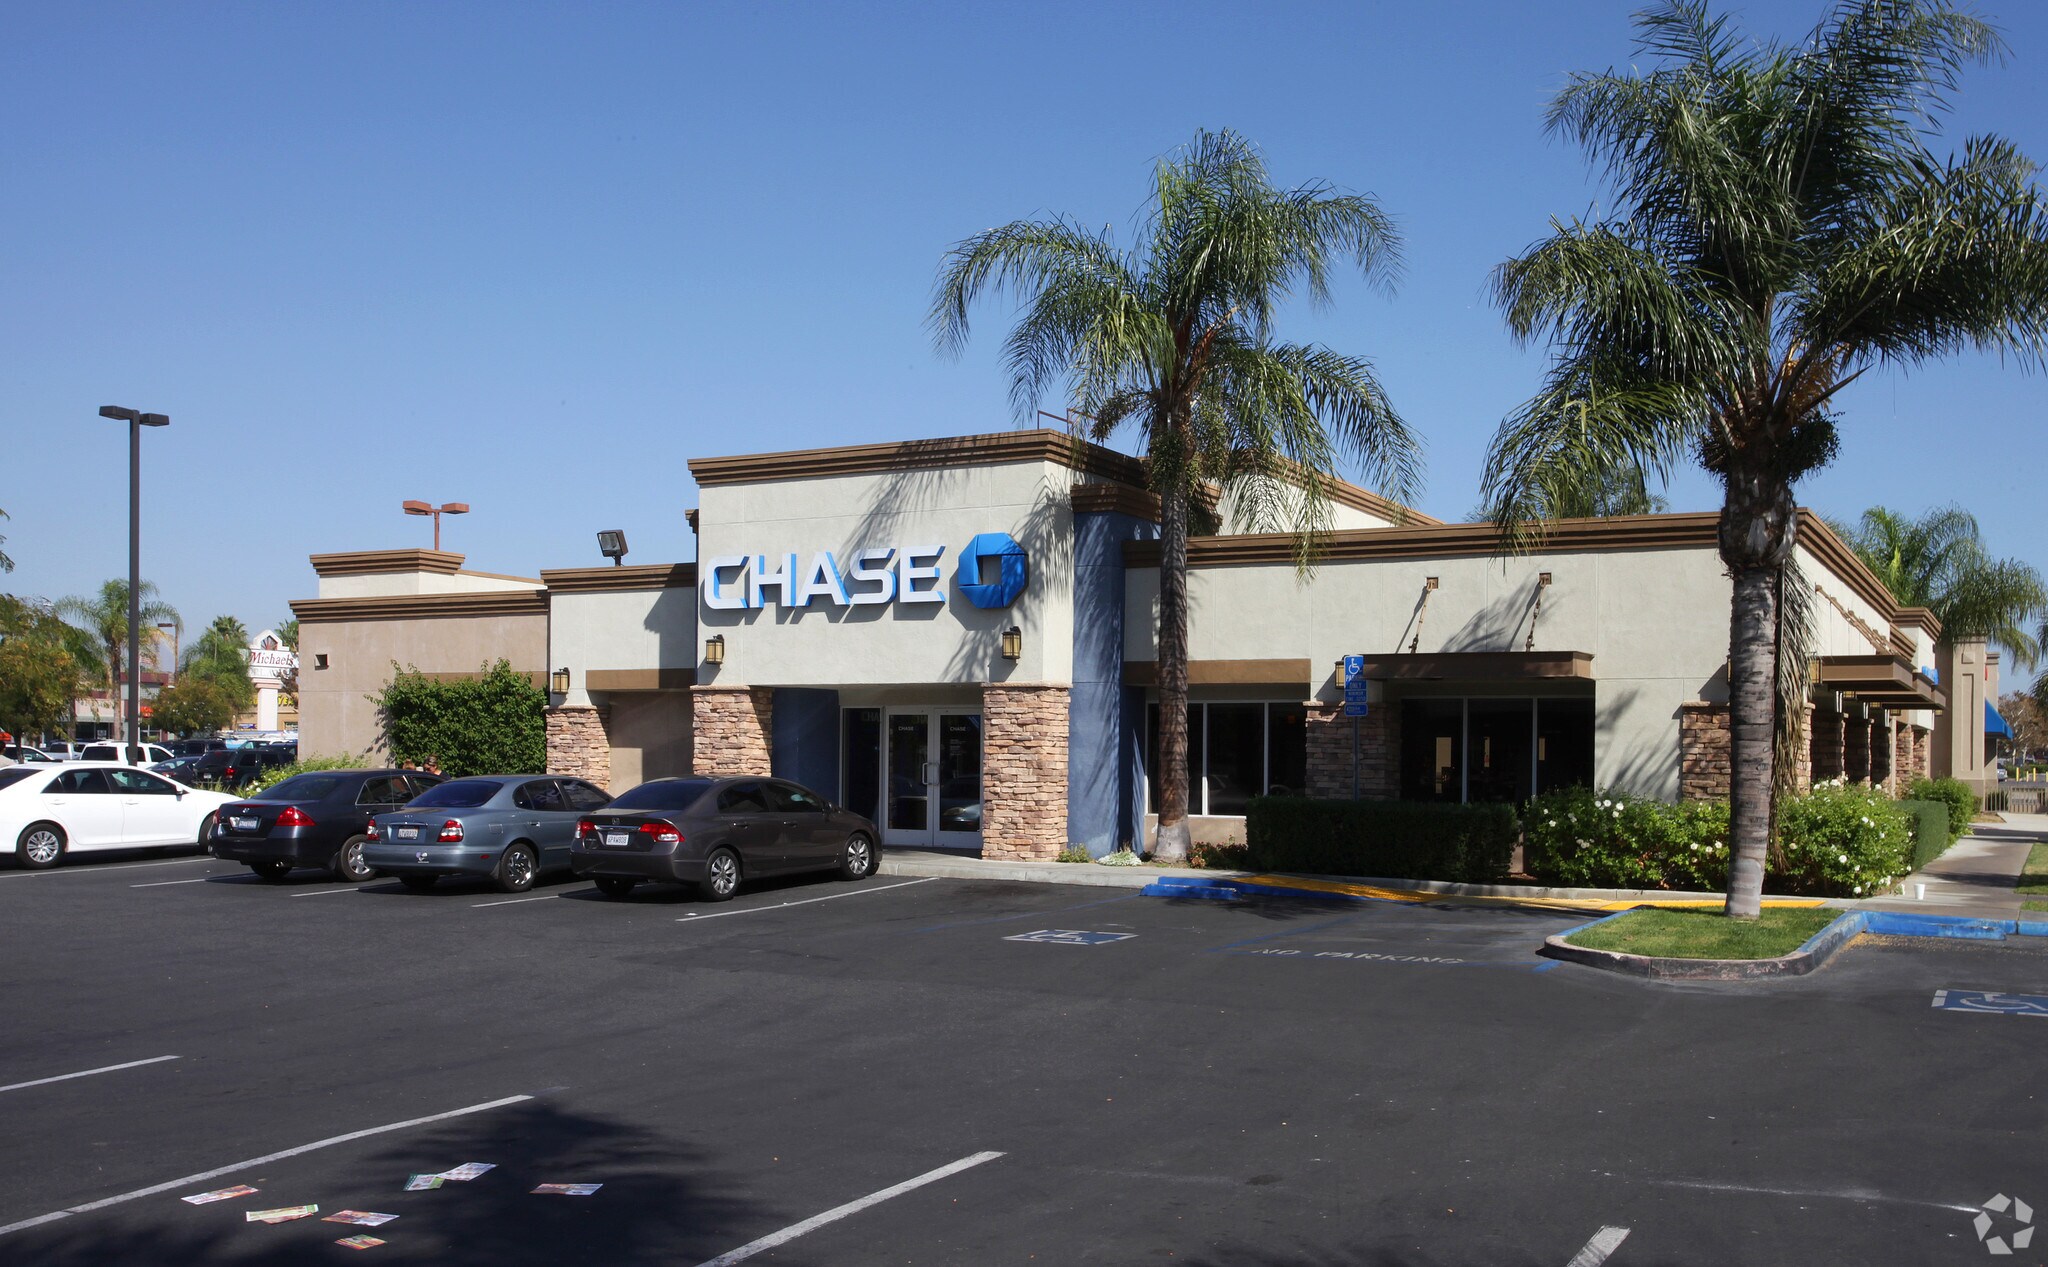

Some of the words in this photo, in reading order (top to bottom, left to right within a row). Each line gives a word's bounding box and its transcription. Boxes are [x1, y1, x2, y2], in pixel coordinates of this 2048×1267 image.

[704, 545, 946, 609] CHASE
[249, 652, 294, 666] Michaels
[1314, 951, 1464, 964] PARKING
